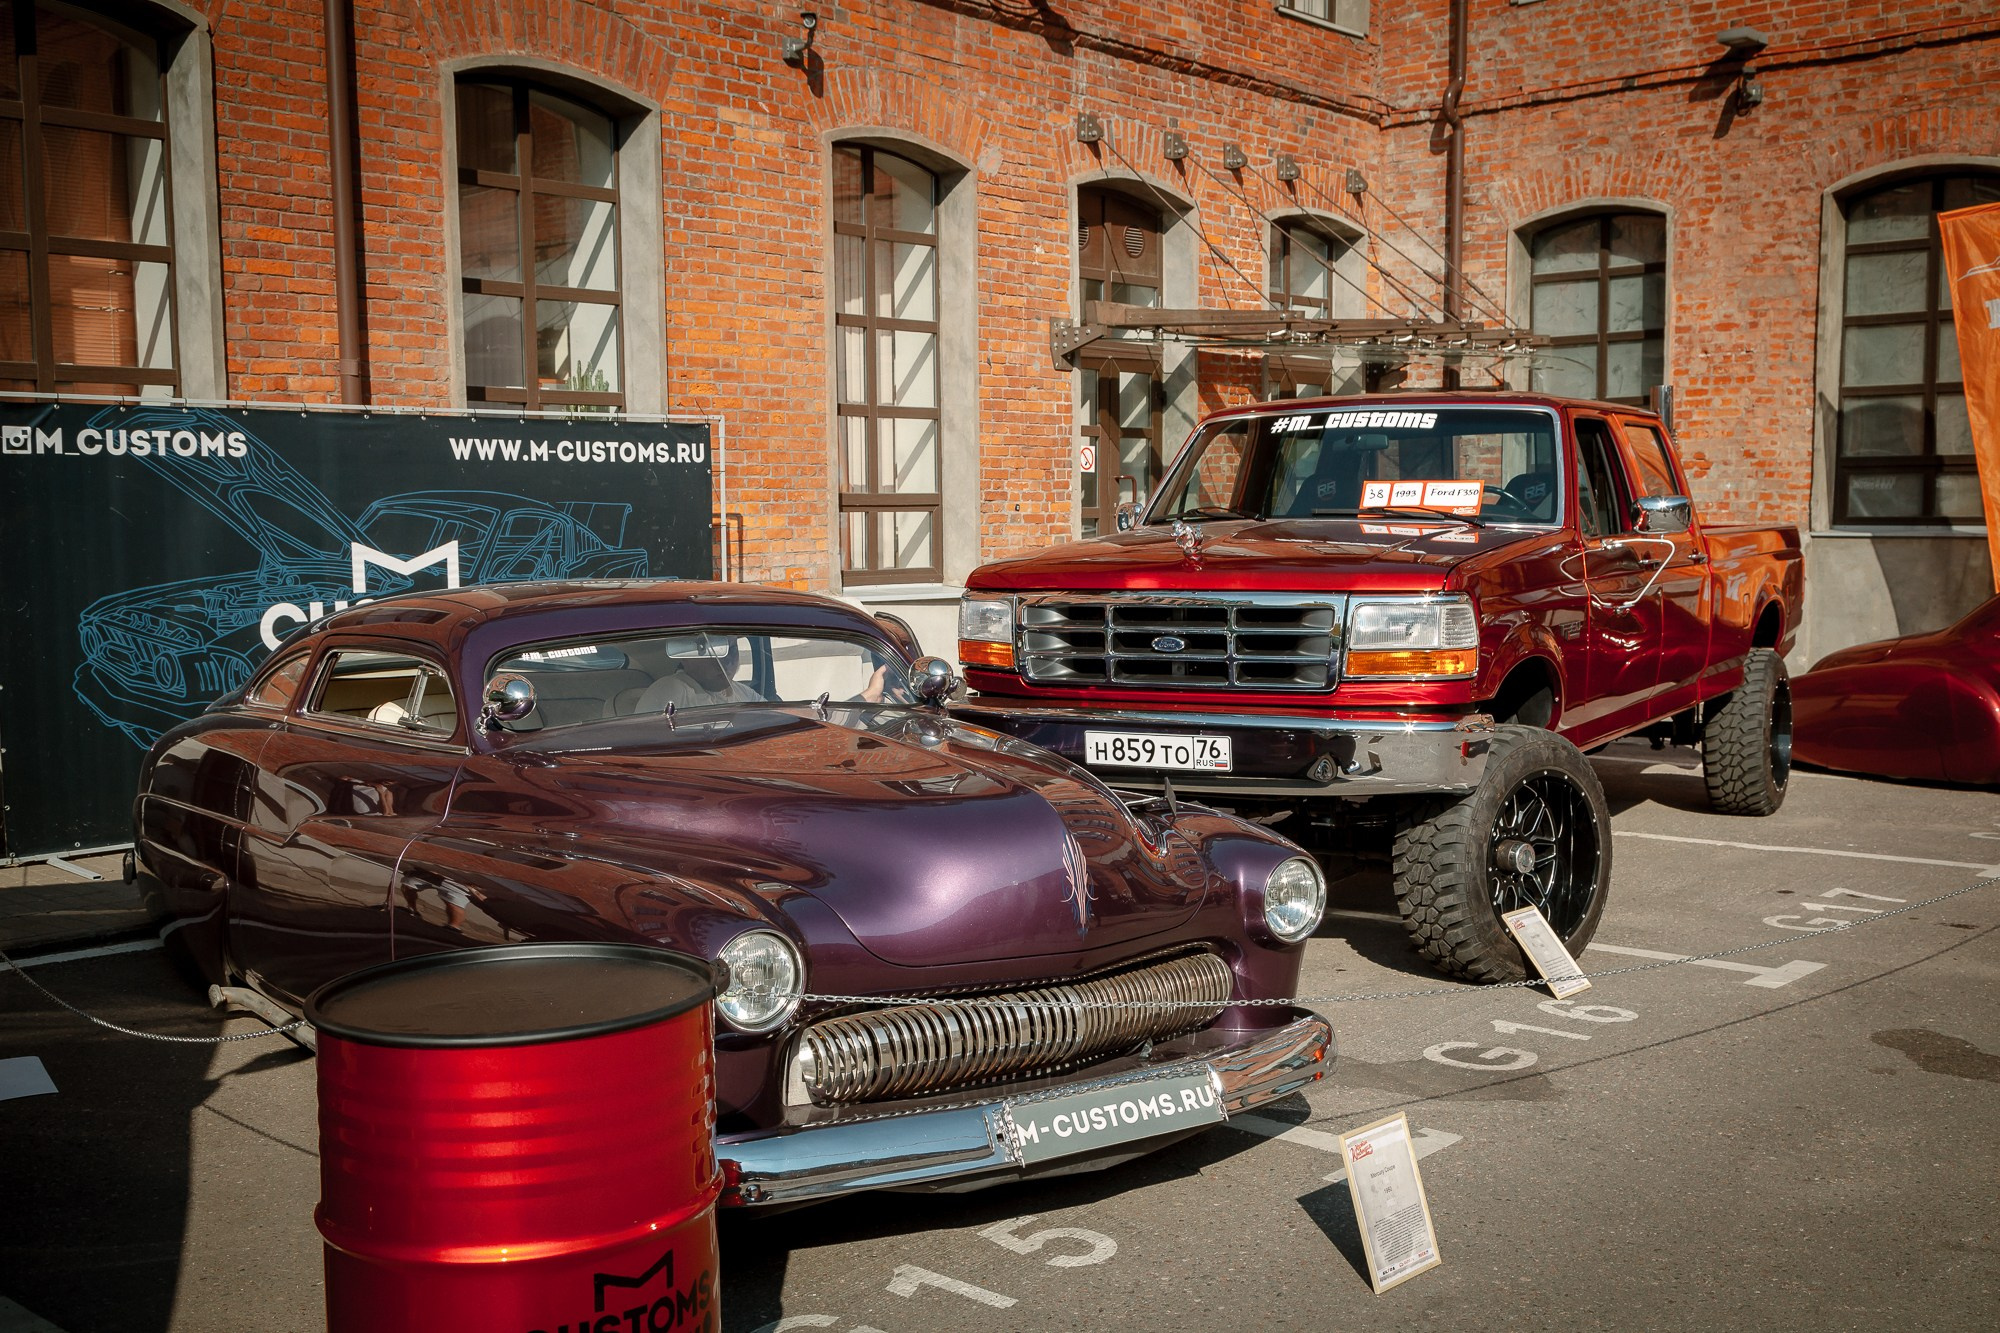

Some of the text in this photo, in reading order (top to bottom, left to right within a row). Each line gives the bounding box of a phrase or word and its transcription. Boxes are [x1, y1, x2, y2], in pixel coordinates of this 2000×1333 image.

[35, 427, 248, 458] M_CUSTOMS
[449, 438, 705, 463] WWW.M-CUSTOMS.RU
[1369, 489, 1384, 499] 38
[1395, 489, 1417, 498] 1993
[1430, 488, 1480, 497] Ford F350
[1196, 739, 1221, 759] 76
[1195, 759, 1214, 767] RUS
[1422, 1000, 1640, 1071] G16
[1016, 1085, 1215, 1147] M-CUSTOMS.RU
